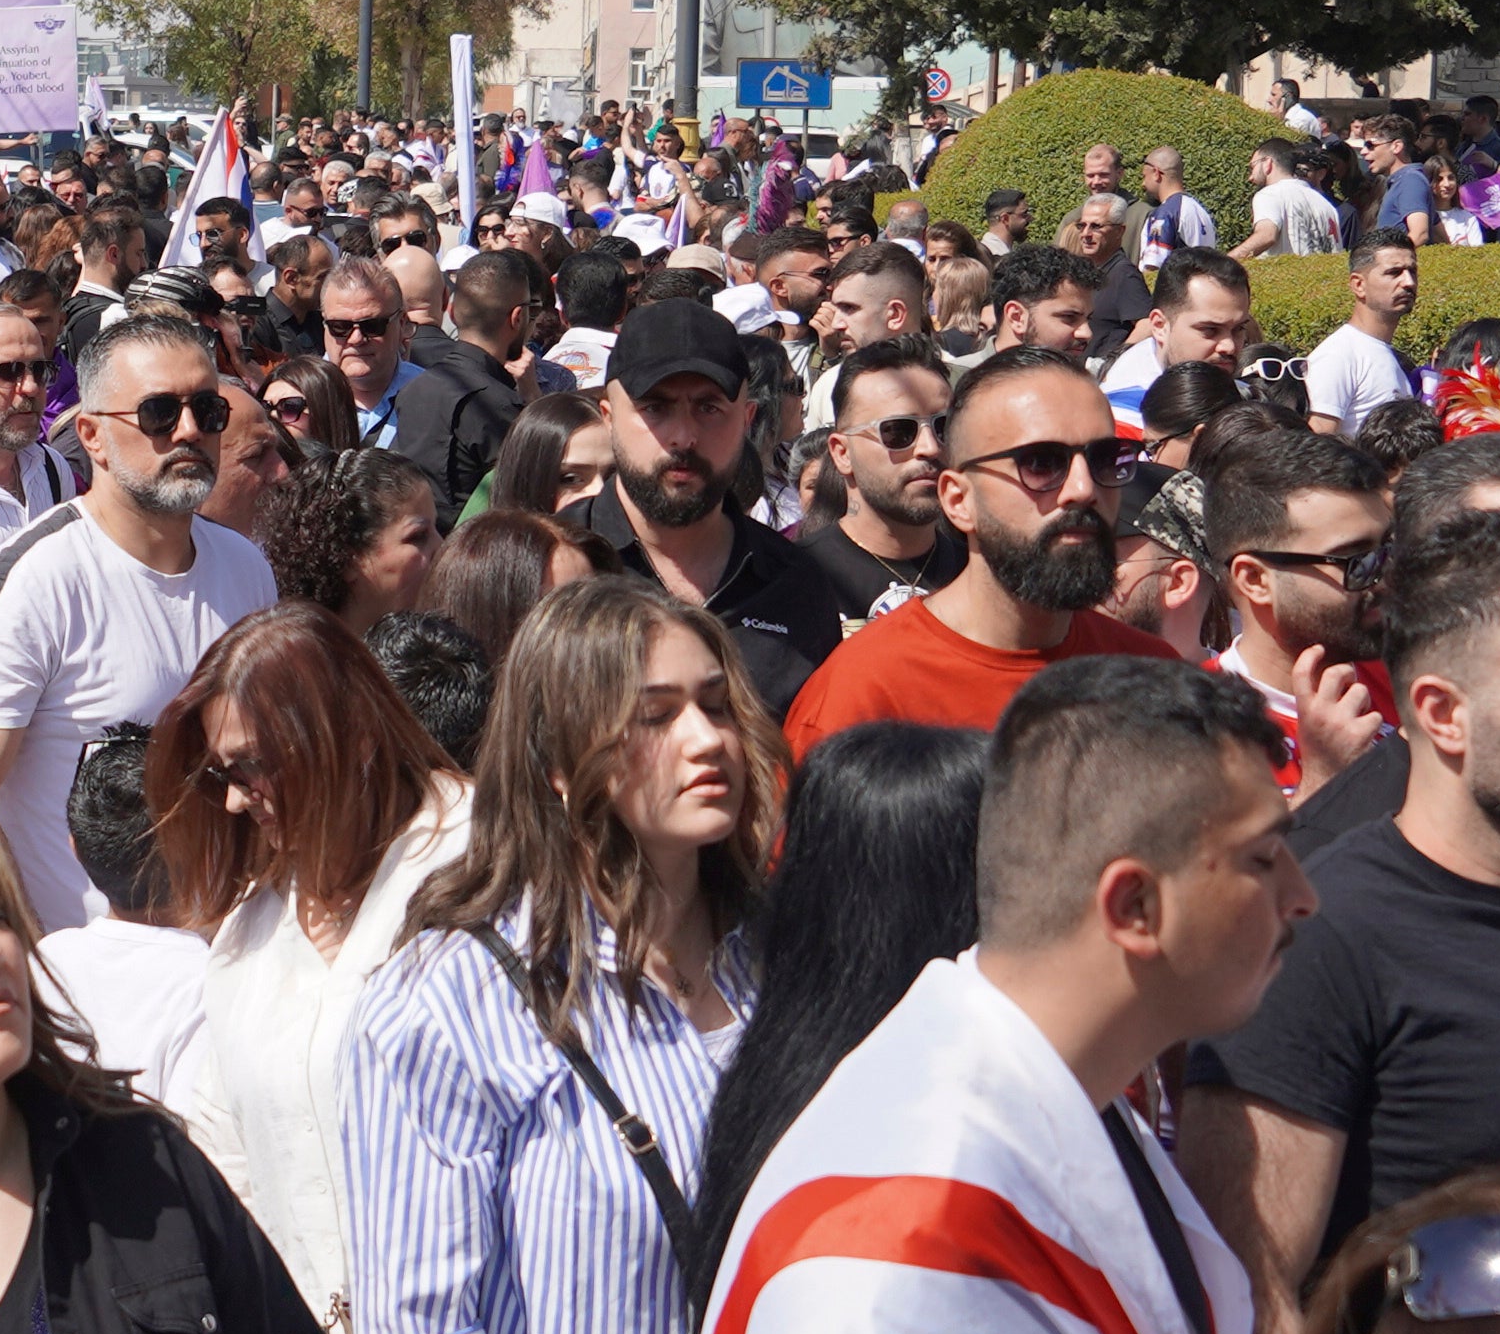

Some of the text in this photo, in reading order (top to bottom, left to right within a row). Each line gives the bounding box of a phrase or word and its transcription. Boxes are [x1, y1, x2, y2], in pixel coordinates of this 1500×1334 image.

[0, 44, 39, 56] Assyrian
[41, 56, 52, 67] of
[36, 82, 65, 94] blood
[750, 618, 789, 635] Columbia
